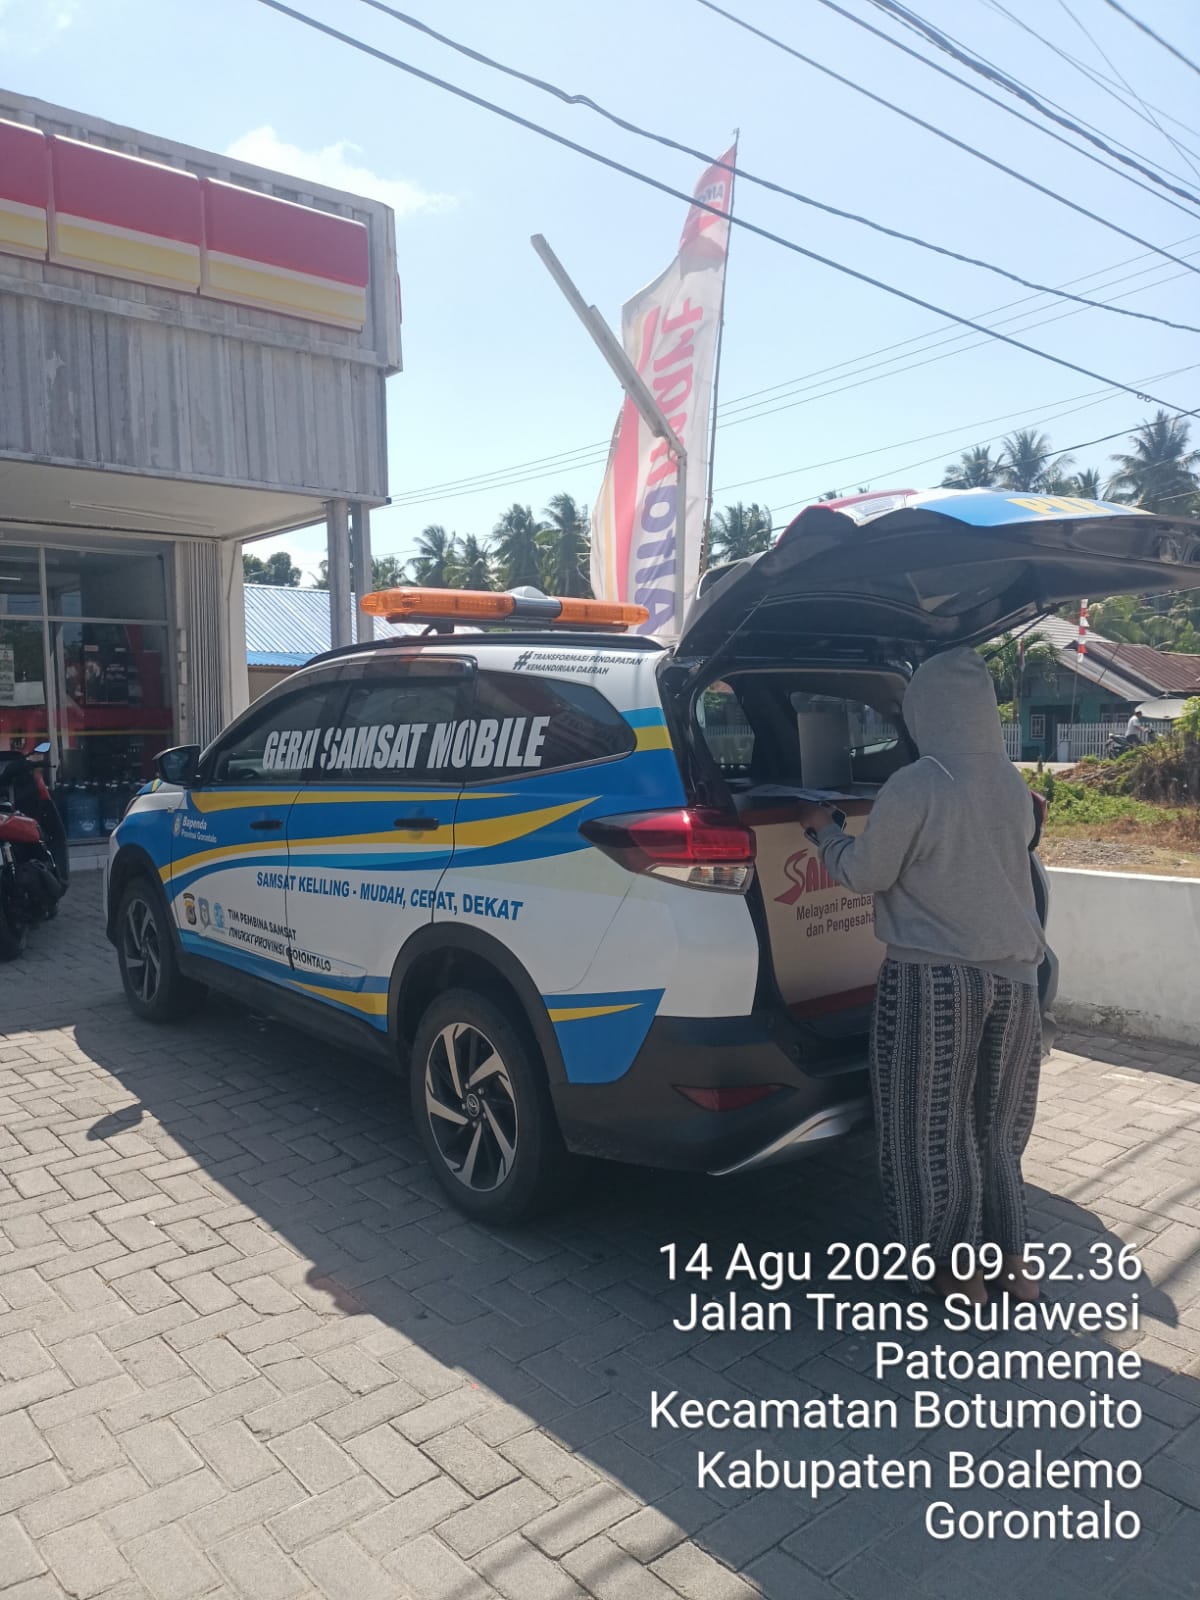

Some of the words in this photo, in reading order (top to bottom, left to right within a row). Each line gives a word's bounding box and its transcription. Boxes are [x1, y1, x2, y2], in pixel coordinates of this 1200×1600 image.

[525, 663, 578, 673] KEMANDIRIAN
[576, 665, 609, 675] DAERAH
[532, 653, 590, 662] TRANSFORMASI
[588, 655, 643, 666] PENDAPATAN
[262, 727, 320, 770] GERAI
[320, 723, 429, 770] SAMSAT
[426, 716, 551, 768] MOBILE
[256, 872, 296, 891] SAMSAT
[299, 876, 350, 898] KELILING
[360, 883, 406, 909] MUDAH,
[410, 889, 458, 915] CEPAT,
[463, 893, 524, 921] DEKAT
[796, 898, 838, 920] Melayani
[840, 894, 874, 911] Pemba
[227, 909, 240, 920] TIM
[239, 912, 268, 930] PEMBINA
[269, 922, 297, 941] SAMSAT
[806, 921, 824, 937] dan
[254, 935, 285, 956] PROVINSI
